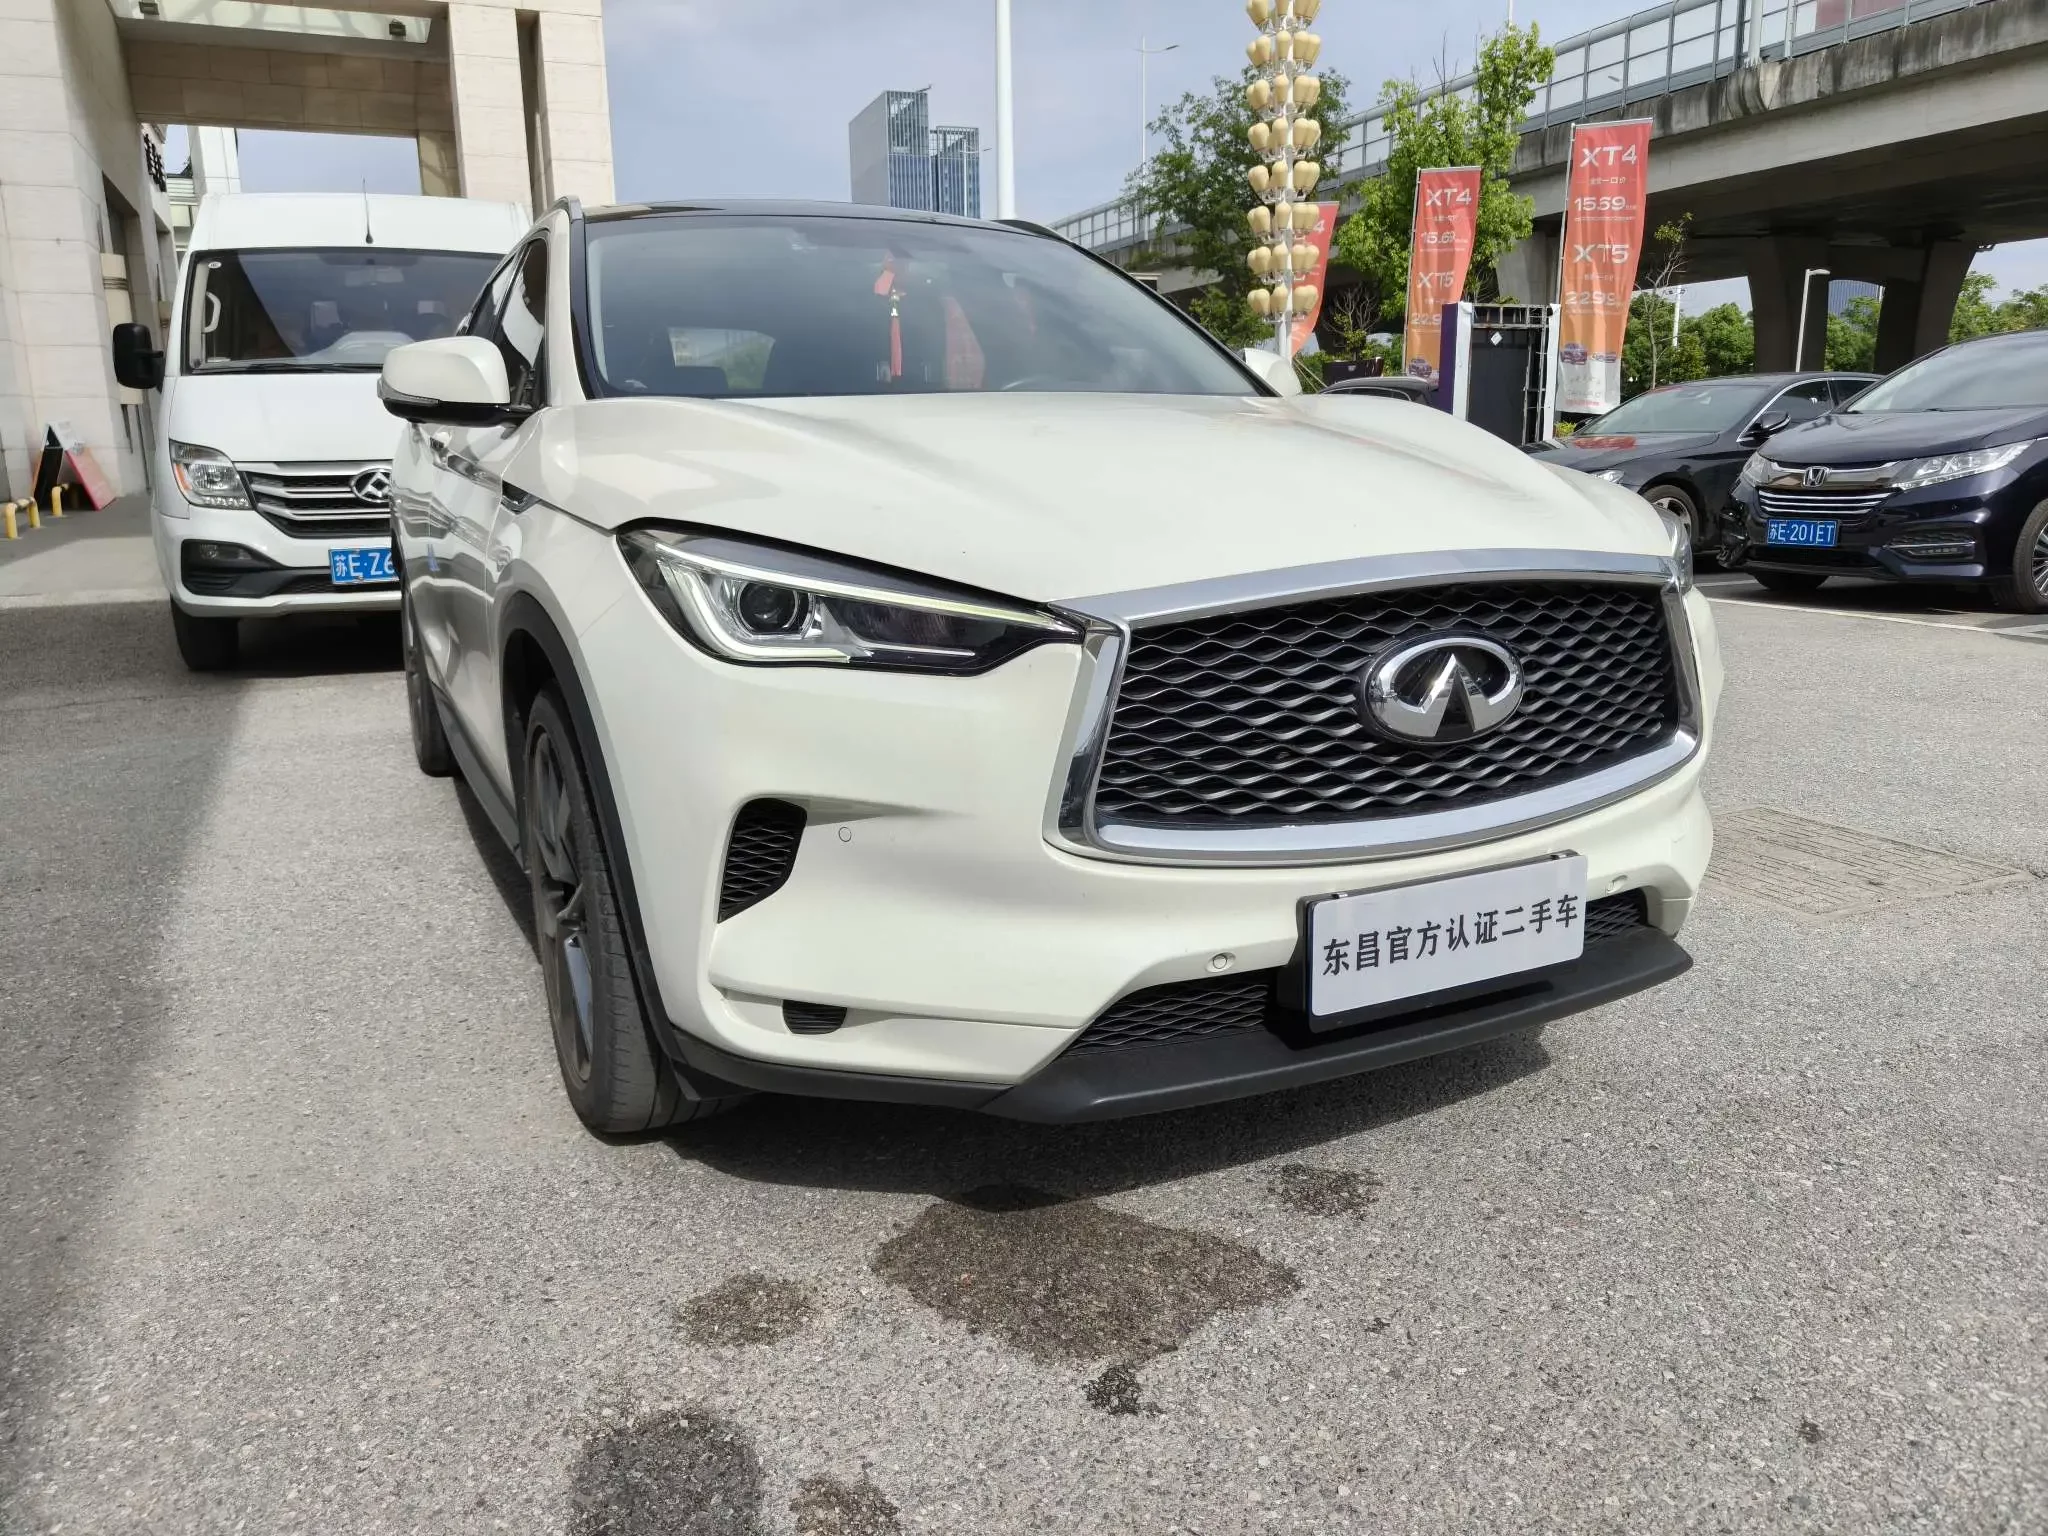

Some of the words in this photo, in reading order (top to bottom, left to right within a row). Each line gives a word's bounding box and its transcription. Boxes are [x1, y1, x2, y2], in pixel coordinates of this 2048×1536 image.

[1580, 144, 1637, 168] XT4
[1425, 187, 1472, 206] XT4
[1573, 243, 1630, 264] XT5
[1416, 271, 1455, 290] XT5
[1322, 894, 1580, 976] 东昌官方认证二手车
